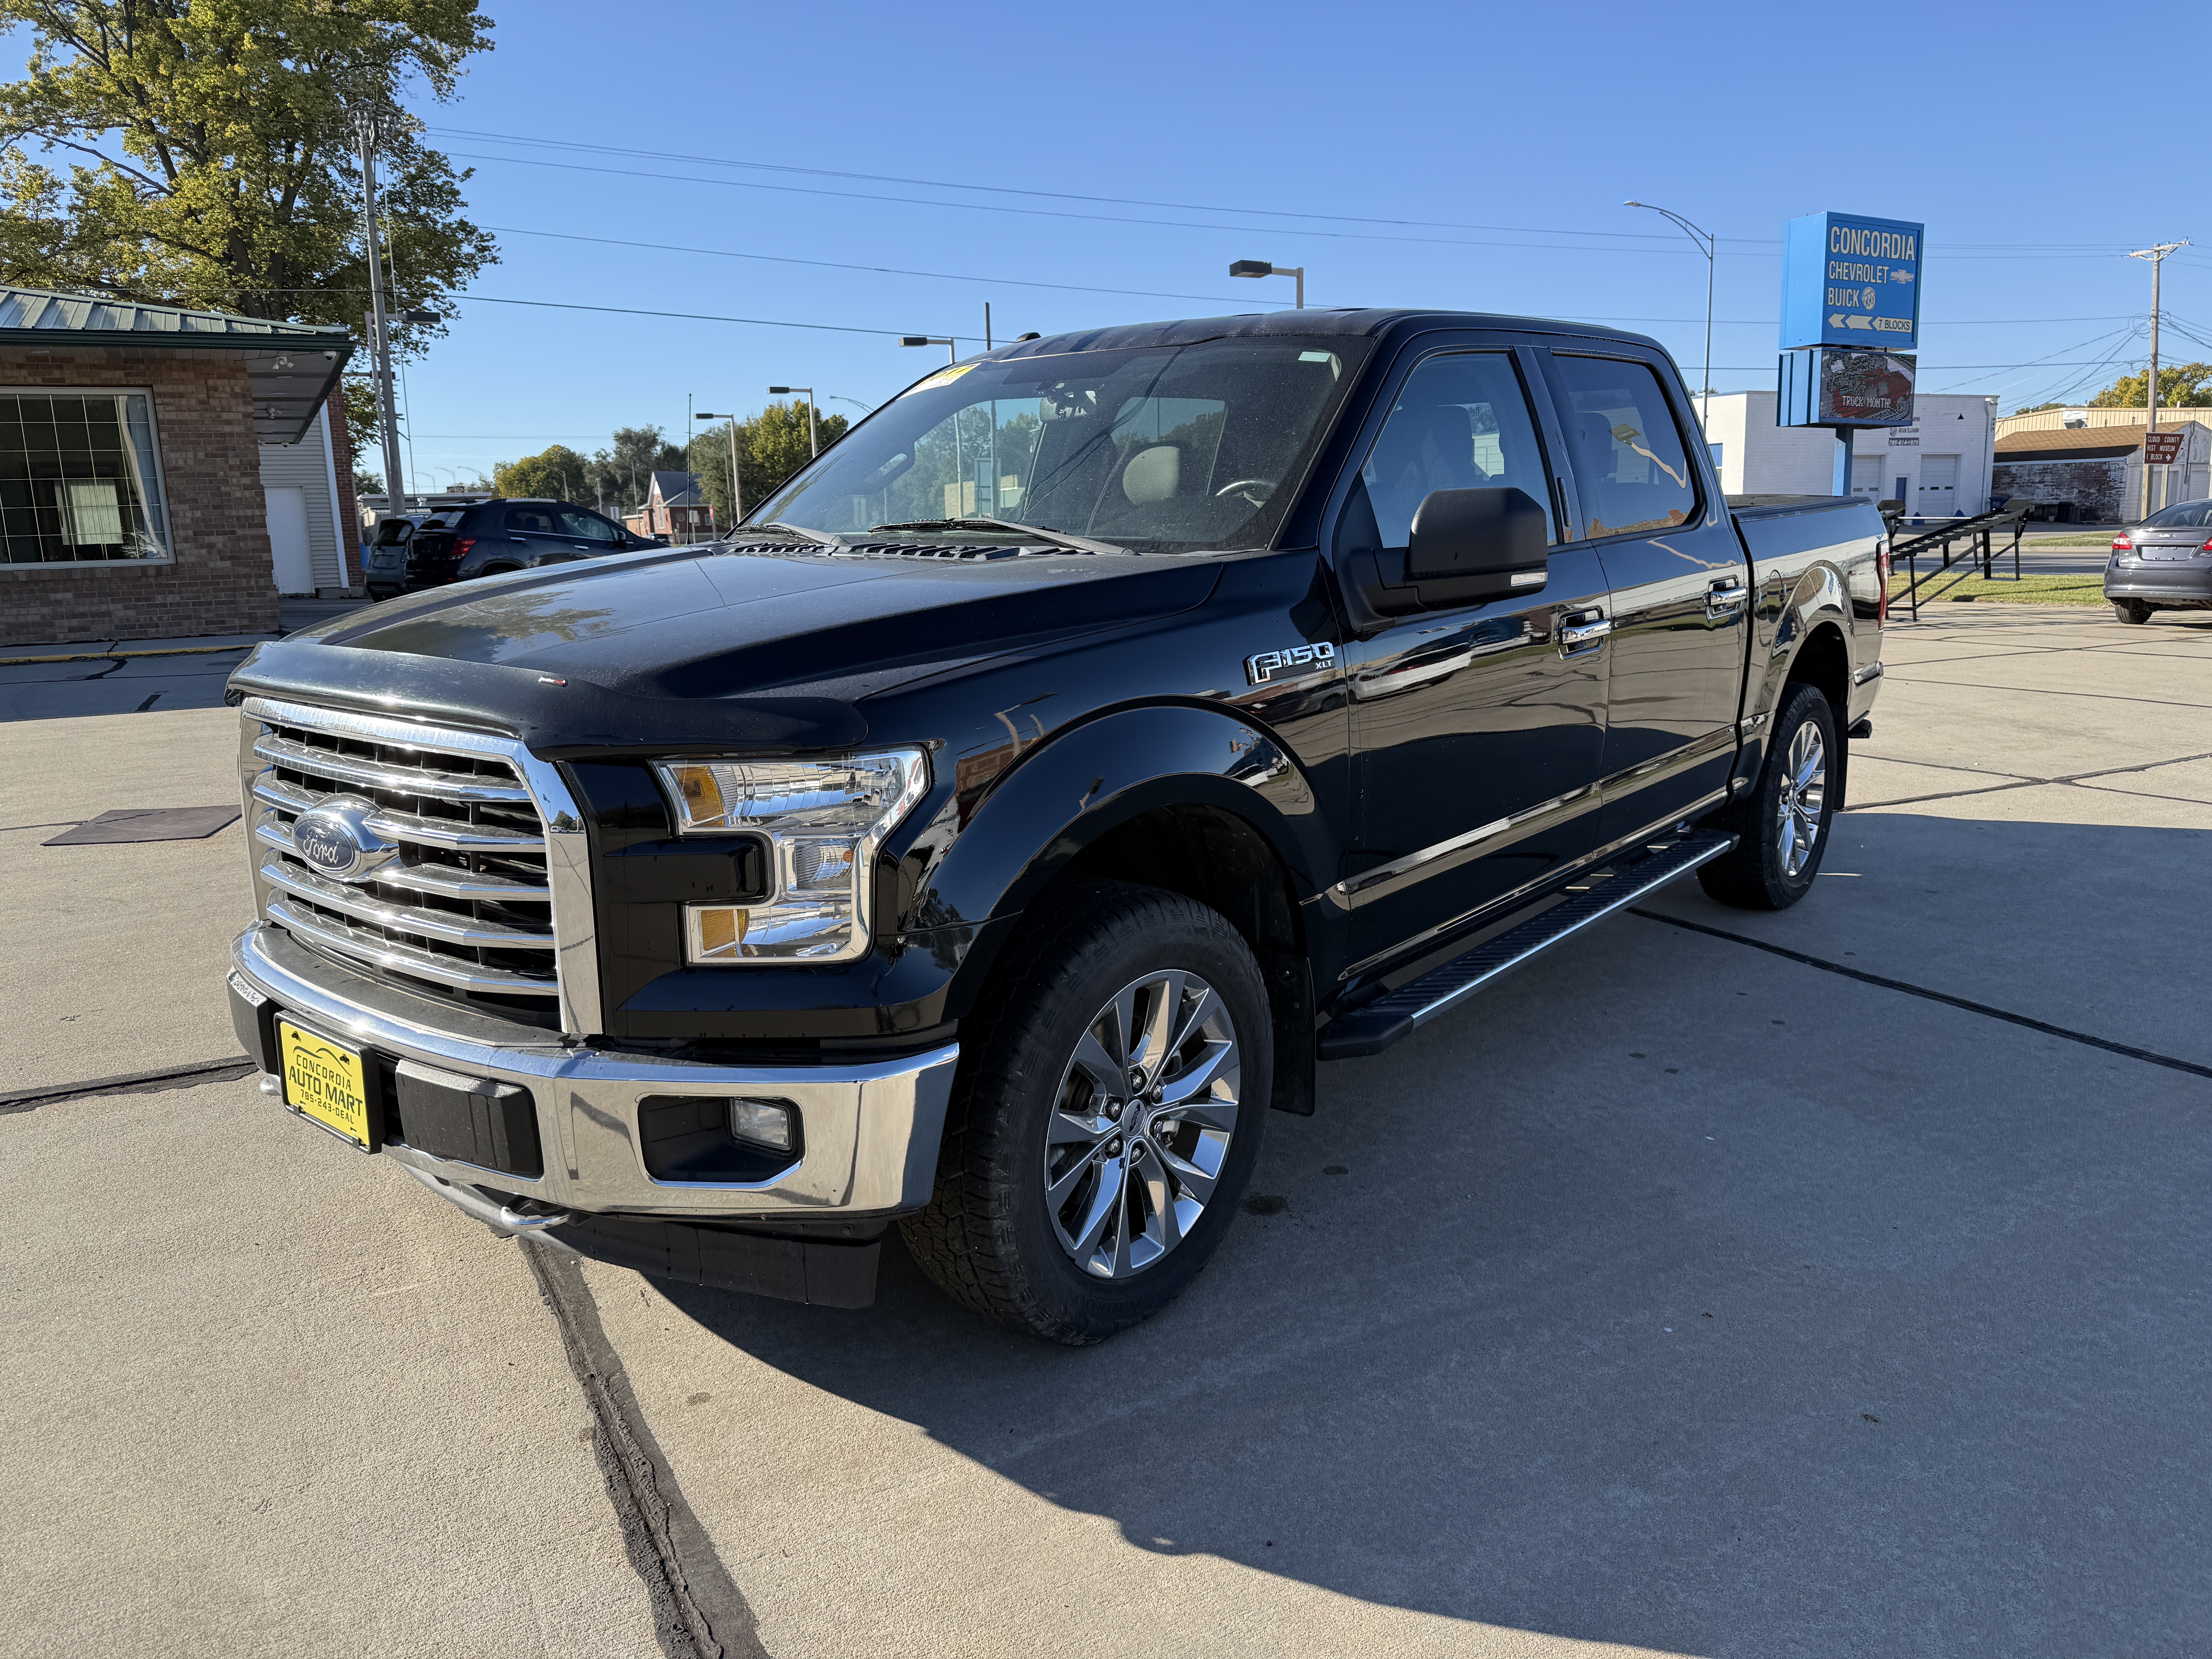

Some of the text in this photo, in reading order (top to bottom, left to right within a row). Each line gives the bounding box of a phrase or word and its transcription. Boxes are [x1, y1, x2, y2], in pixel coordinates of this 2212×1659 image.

[1831, 226, 1915, 261] CONCORDIA
[1829, 260, 1889, 284] CHEVROLET
[1828, 287, 1860, 307] BUICK
[1879, 319, 1910, 330] 7 BLOCKS
[1842, 396, 1891, 408] TRUCK MONTH!
[1316, 660, 1332, 669] XLT
[303, 826, 339, 864] Ford
[297, 1054, 352, 1092] CONCORDIA
[289, 1065, 363, 1116] AUTO MART
[301, 1089, 354, 1124] 785-243-DEAL
